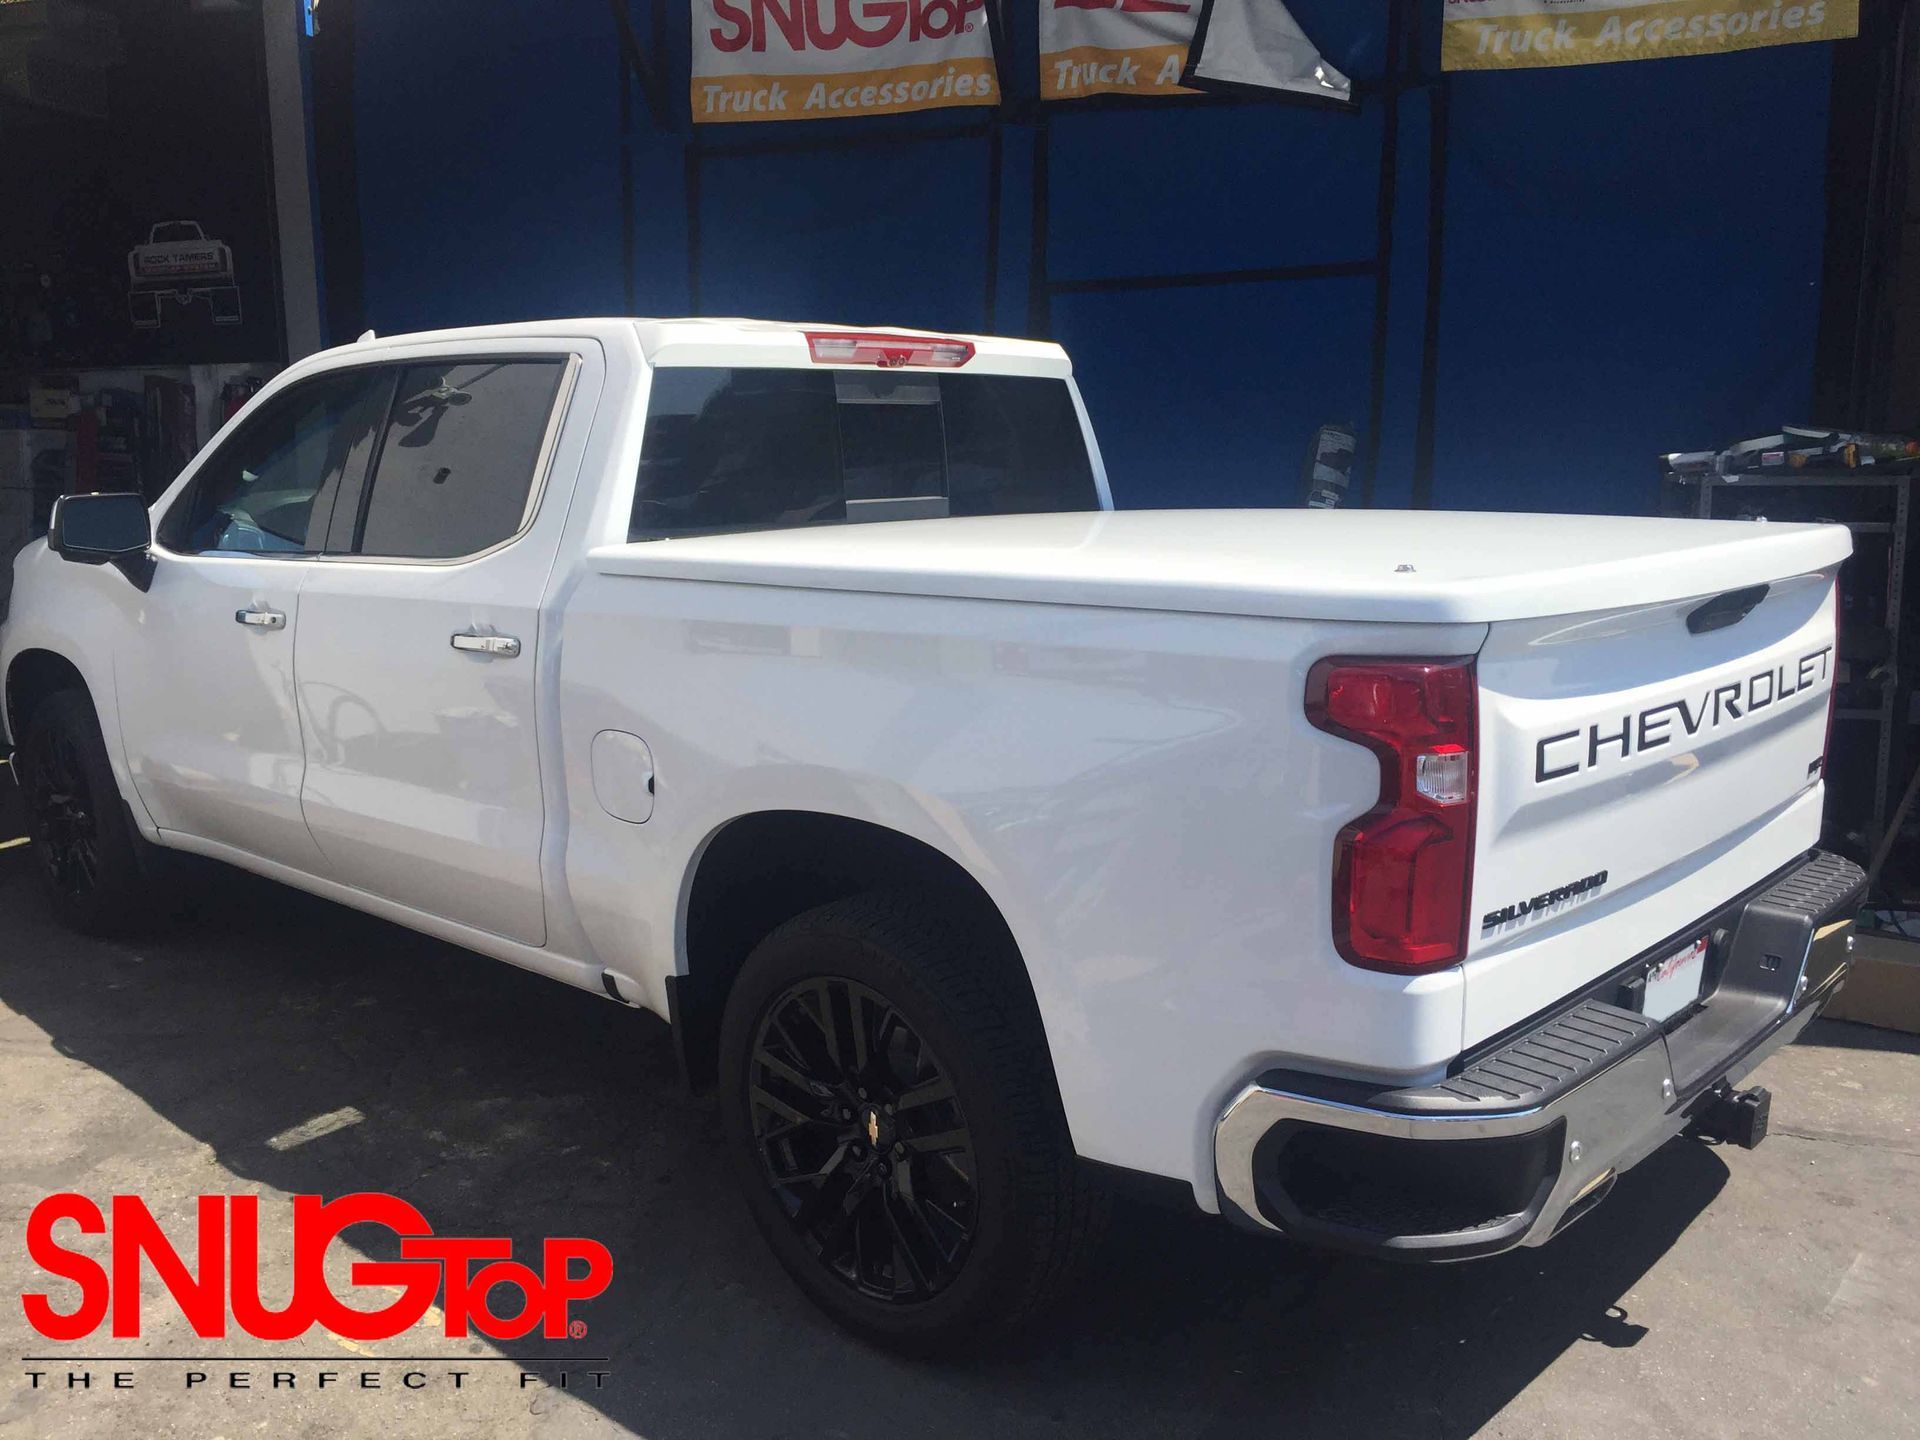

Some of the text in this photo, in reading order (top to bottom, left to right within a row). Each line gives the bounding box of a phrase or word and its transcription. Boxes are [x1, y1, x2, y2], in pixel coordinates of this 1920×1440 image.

[1476, 0, 1826, 56] Truck Accessories
[703, 67, 991, 113] Truck Accessories
[1055, 54, 1180, 90] Truck A
[1535, 646, 1833, 783] CHEVROLET
[1482, 870, 1608, 930] SILVERADO
